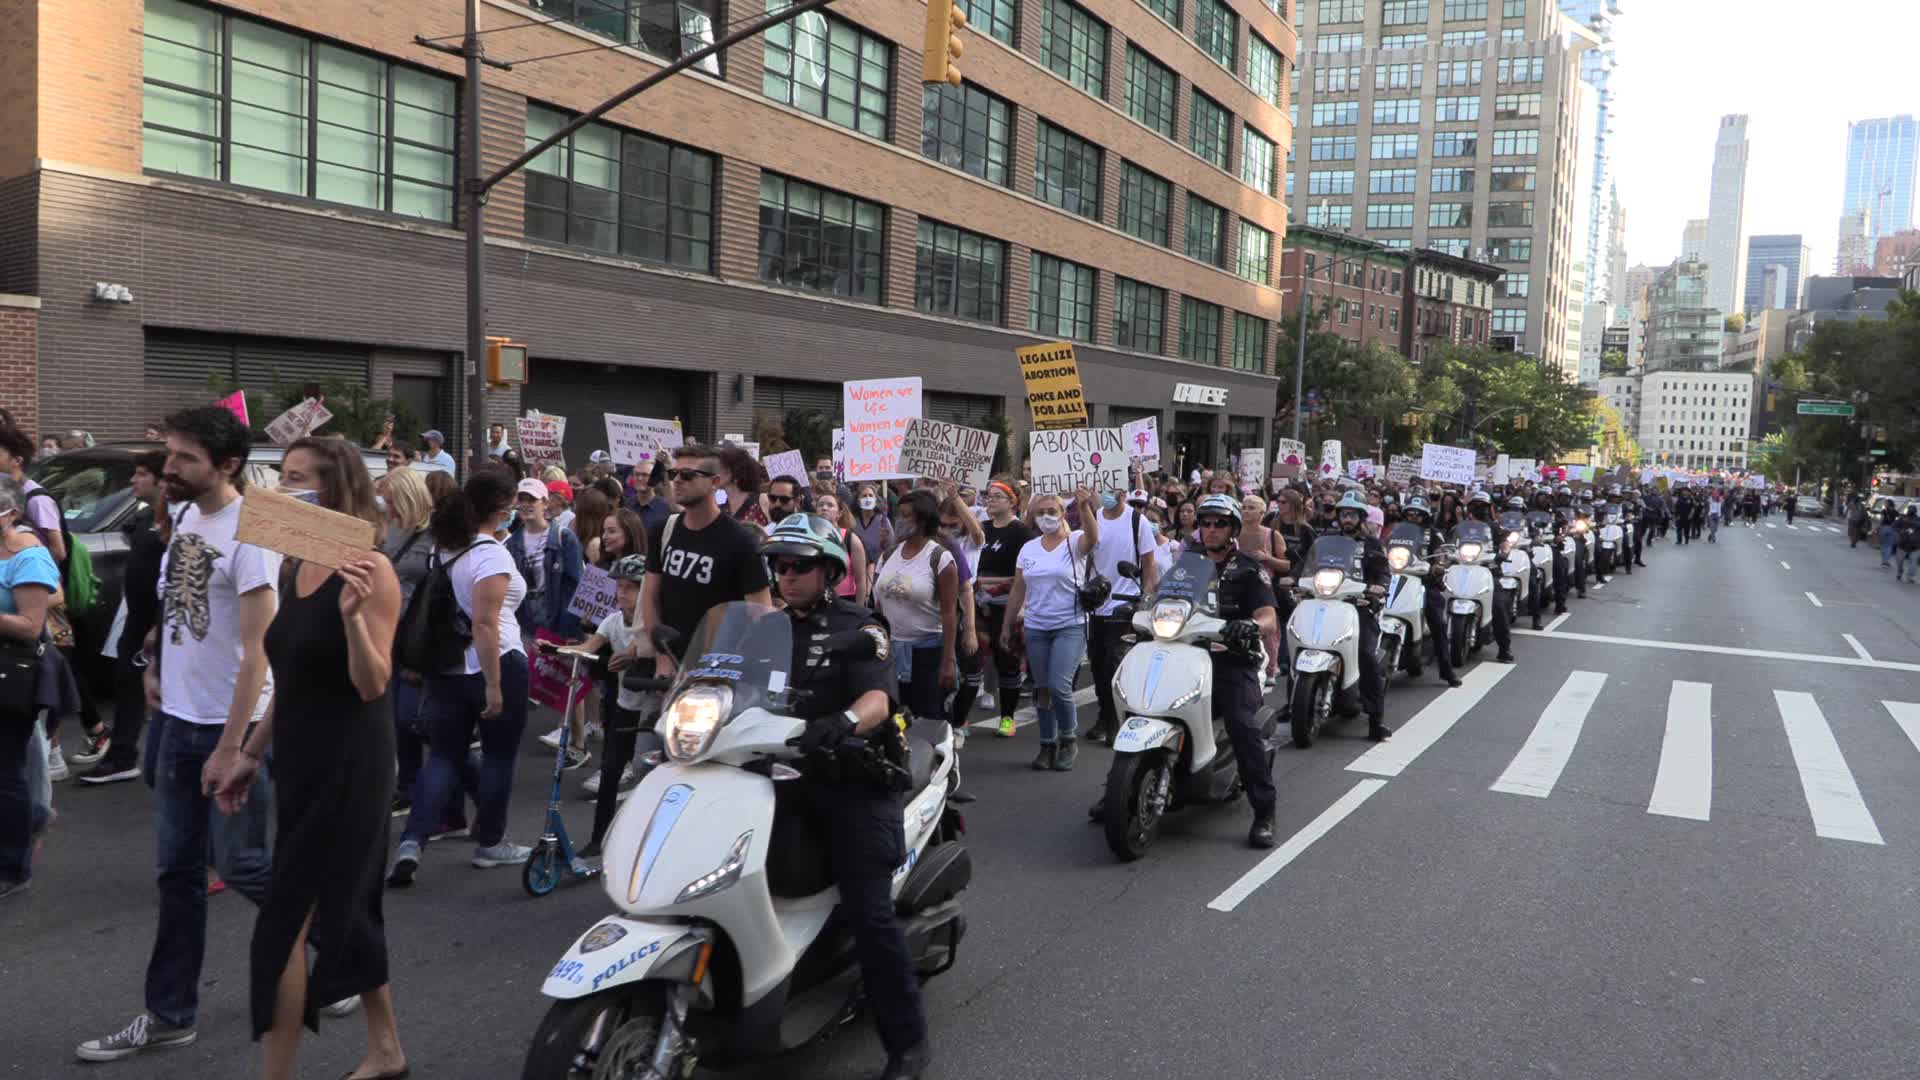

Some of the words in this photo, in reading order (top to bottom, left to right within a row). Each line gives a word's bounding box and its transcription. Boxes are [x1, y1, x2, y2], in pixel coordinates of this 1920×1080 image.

[1020, 349, 1073, 365] LEGALIZE
[1025, 366, 1076, 380] ABORTION
[849, 386, 893, 400] Women
[1029, 391, 1055, 402] ONCE
[1057, 389, 1081, 400] AND
[1034, 405, 1056, 416] FOR
[1057, 402, 1083, 414] ALL!
[849, 420, 891, 433] Women
[906, 418, 993, 453] ABORTION
[919, 439, 957, 456] PERSONAL
[960, 449, 993, 464] DECISION
[1032, 429, 1124, 453] ABORTION
[849, 458, 872, 477] be
[907, 458, 948, 481] DEFEND
[950, 465, 974, 486] ROE
[926, 450, 951, 464] LEGAL
[954, 456, 985, 472] DEBATE
[1066, 452, 1085, 472] IS
[1032, 469, 1123, 494] HEALTHCARE
[663, 546, 714, 584] 1973
[572, 596, 609, 620] BODIES
[595, 591, 617, 609] OUR
[1144, 727, 1169, 749] POLICE
[591, 941, 660, 990] POLICE
